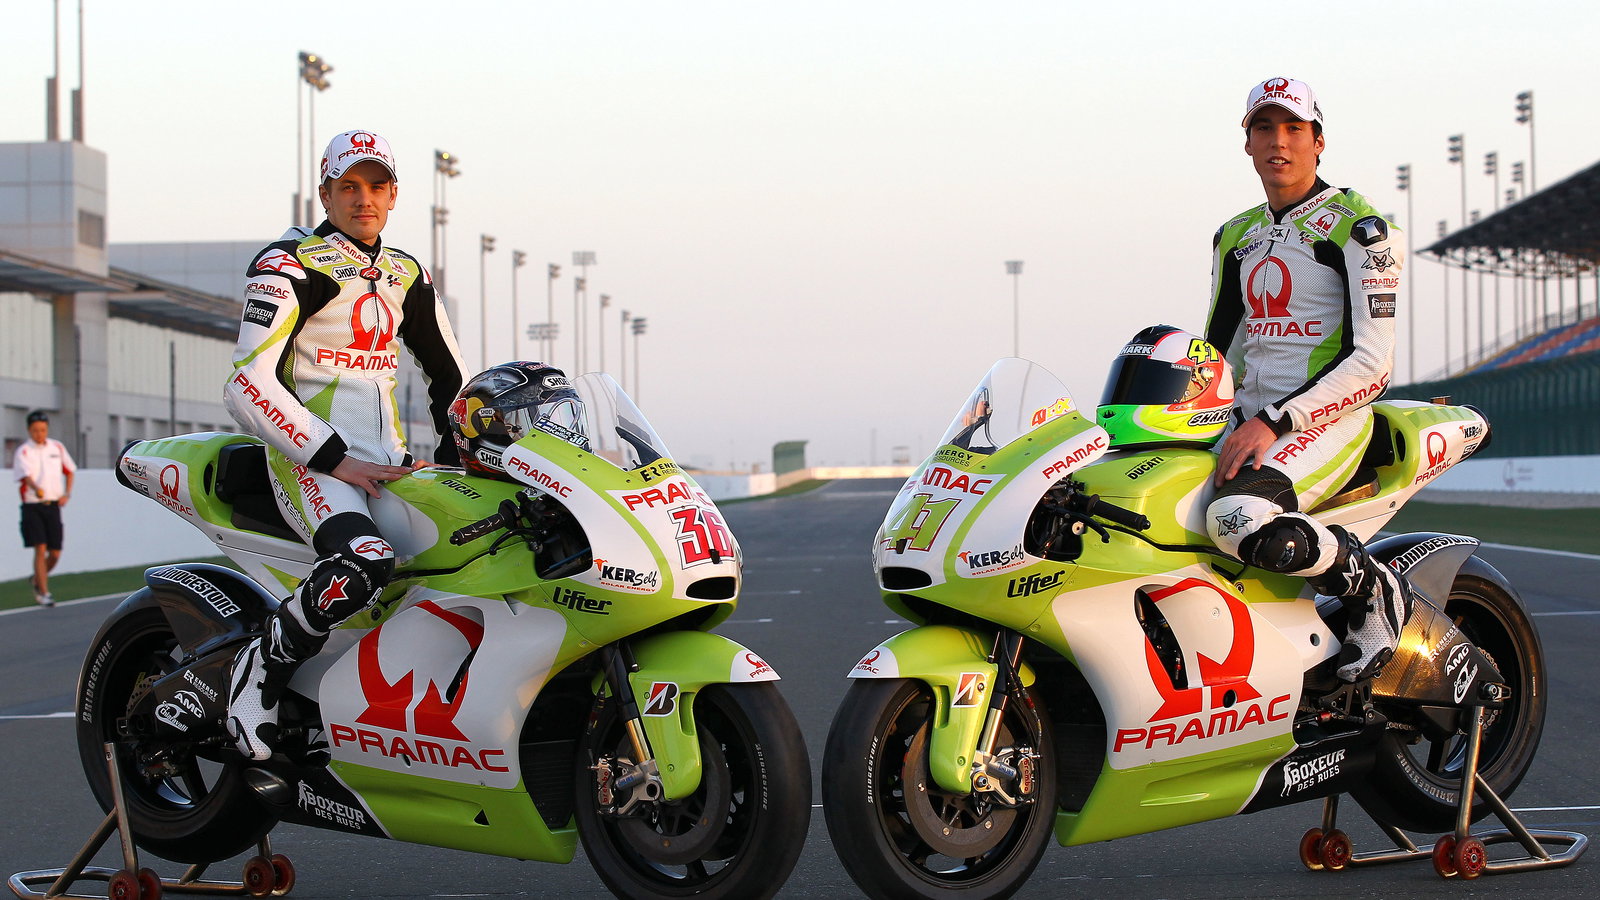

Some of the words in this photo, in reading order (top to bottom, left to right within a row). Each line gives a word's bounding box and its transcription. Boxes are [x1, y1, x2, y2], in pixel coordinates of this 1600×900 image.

[338, 147, 389, 162] PRAMAC
[1289, 193, 1327, 220] PRAMAC
[331, 235, 369, 264] PRAMAC
[335, 266, 357, 279] SHOEI
[1361, 278, 1399, 286] PRAMAC
[316, 348, 398, 370] PRAMAC
[1120, 345, 1154, 355] HARK
[1187, 338, 1220, 365] 41
[233, 373, 310, 448] PRAMAC
[1310, 372, 1390, 423] PRAMAC
[1272, 416, 1341, 465] PRAM
[480, 451, 503, 468] SHOE
[1042, 436, 1106, 479] PRAMAC
[1127, 456, 1165, 480] DUCATI
[1415, 457, 1452, 485] PRAMAC
[286, 457, 333, 521] RAMAC
[441, 479, 482, 499] DUCATI
[507, 456, 573, 499] PRAMAC
[156, 491, 193, 516] PRAMAC
[880, 493, 962, 552] 41
[668, 506, 735, 569] 36
[1389, 535, 1479, 575] BRIDGESTONE
[150, 567, 242, 618] BRIDGESTONE
[1007, 570, 1065, 598] Lifter
[553, 586, 612, 616] Lifter
[82, 639, 113, 724] BRIDGESTONE
[1112, 694, 1291, 753] PRAMAC
[330, 723, 510, 773] PRAMAC
[1292, 749, 1346, 786] BOXEUR
[1296, 779, 1315, 792] DES
[1317, 765, 1341, 784] RUES
[307, 791, 366, 825] BOXEUR
[315, 808, 333, 821] DES
[336, 815, 361, 830] RUES
